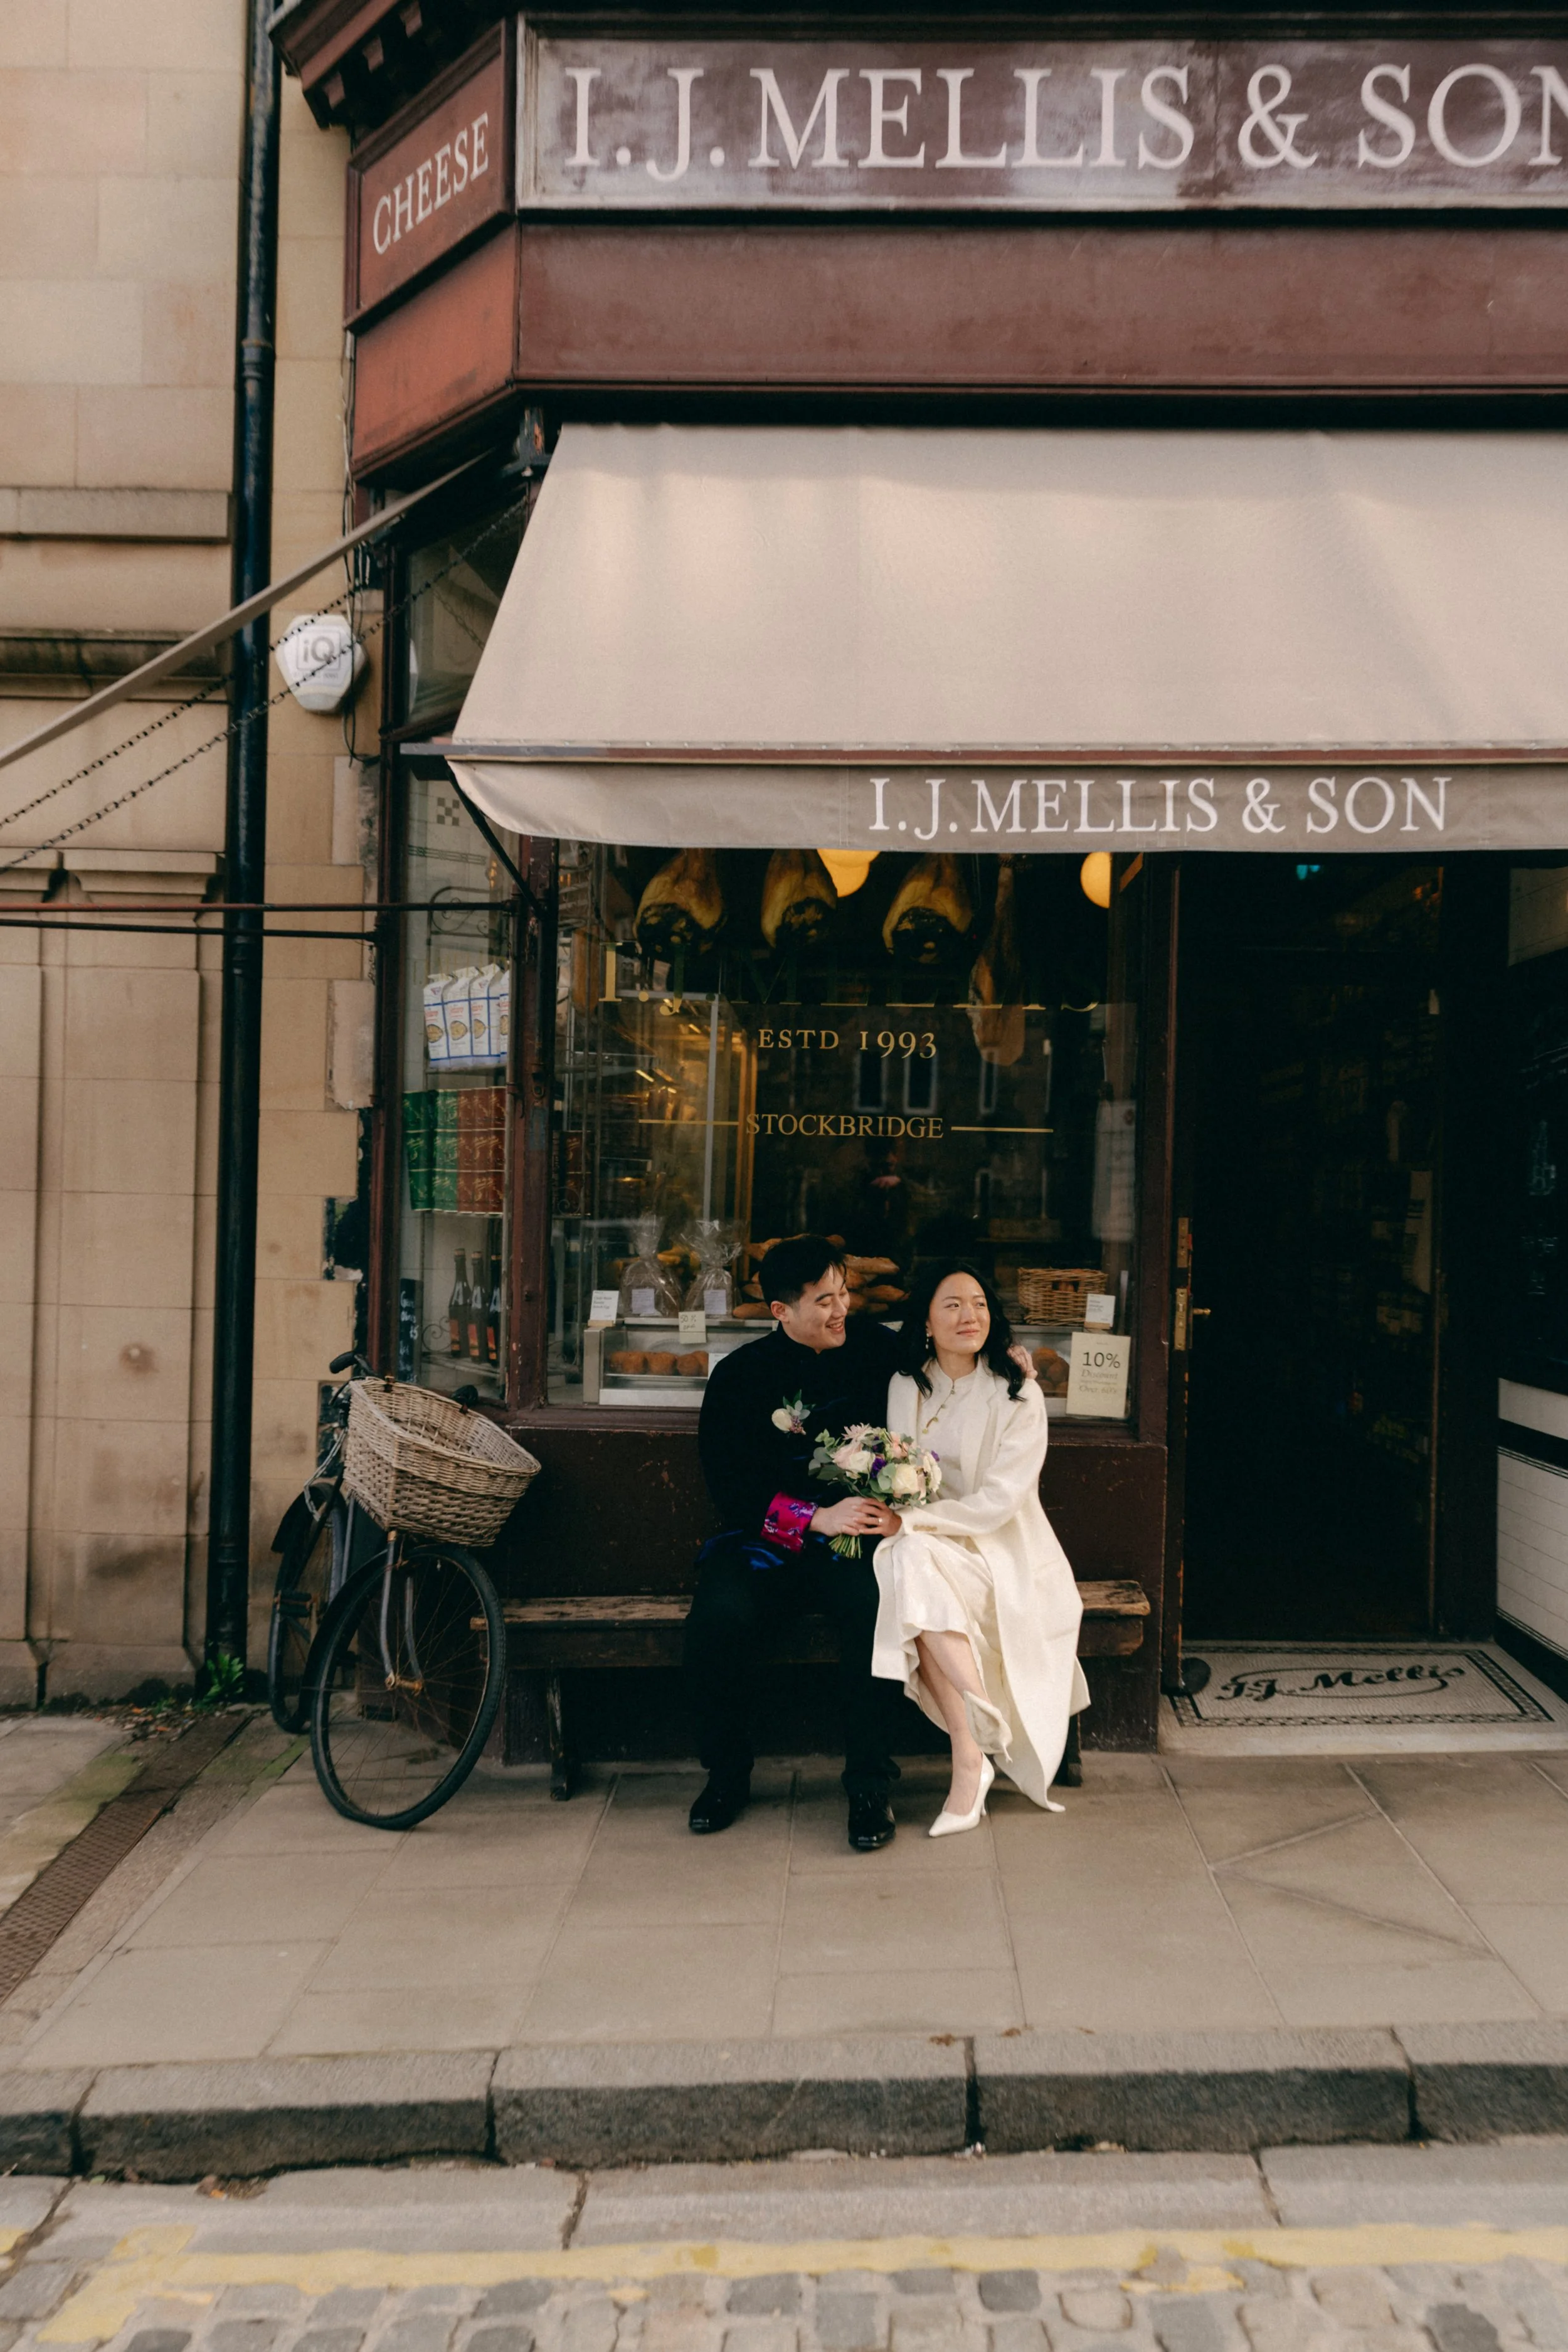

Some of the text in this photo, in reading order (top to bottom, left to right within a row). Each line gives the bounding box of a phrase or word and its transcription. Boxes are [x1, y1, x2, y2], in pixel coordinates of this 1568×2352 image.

[564, 66, 726, 183] I.J.
[746, 65, 1194, 171] MELLIS
[1237, 63, 1318, 170] &
[372, 112, 490, 255] CHEESE
[869, 776, 1453, 841] I.J. MELLIS & SON
[758, 1029, 938, 1059] ESTD 1993
[745, 1113, 944, 1139] STOCKBRIDGE
[1082, 1351, 1121, 1369] 10%
[1081, 1369, 1118, 1380] Discount
[1300, 1664, 1466, 1691] Mellis
